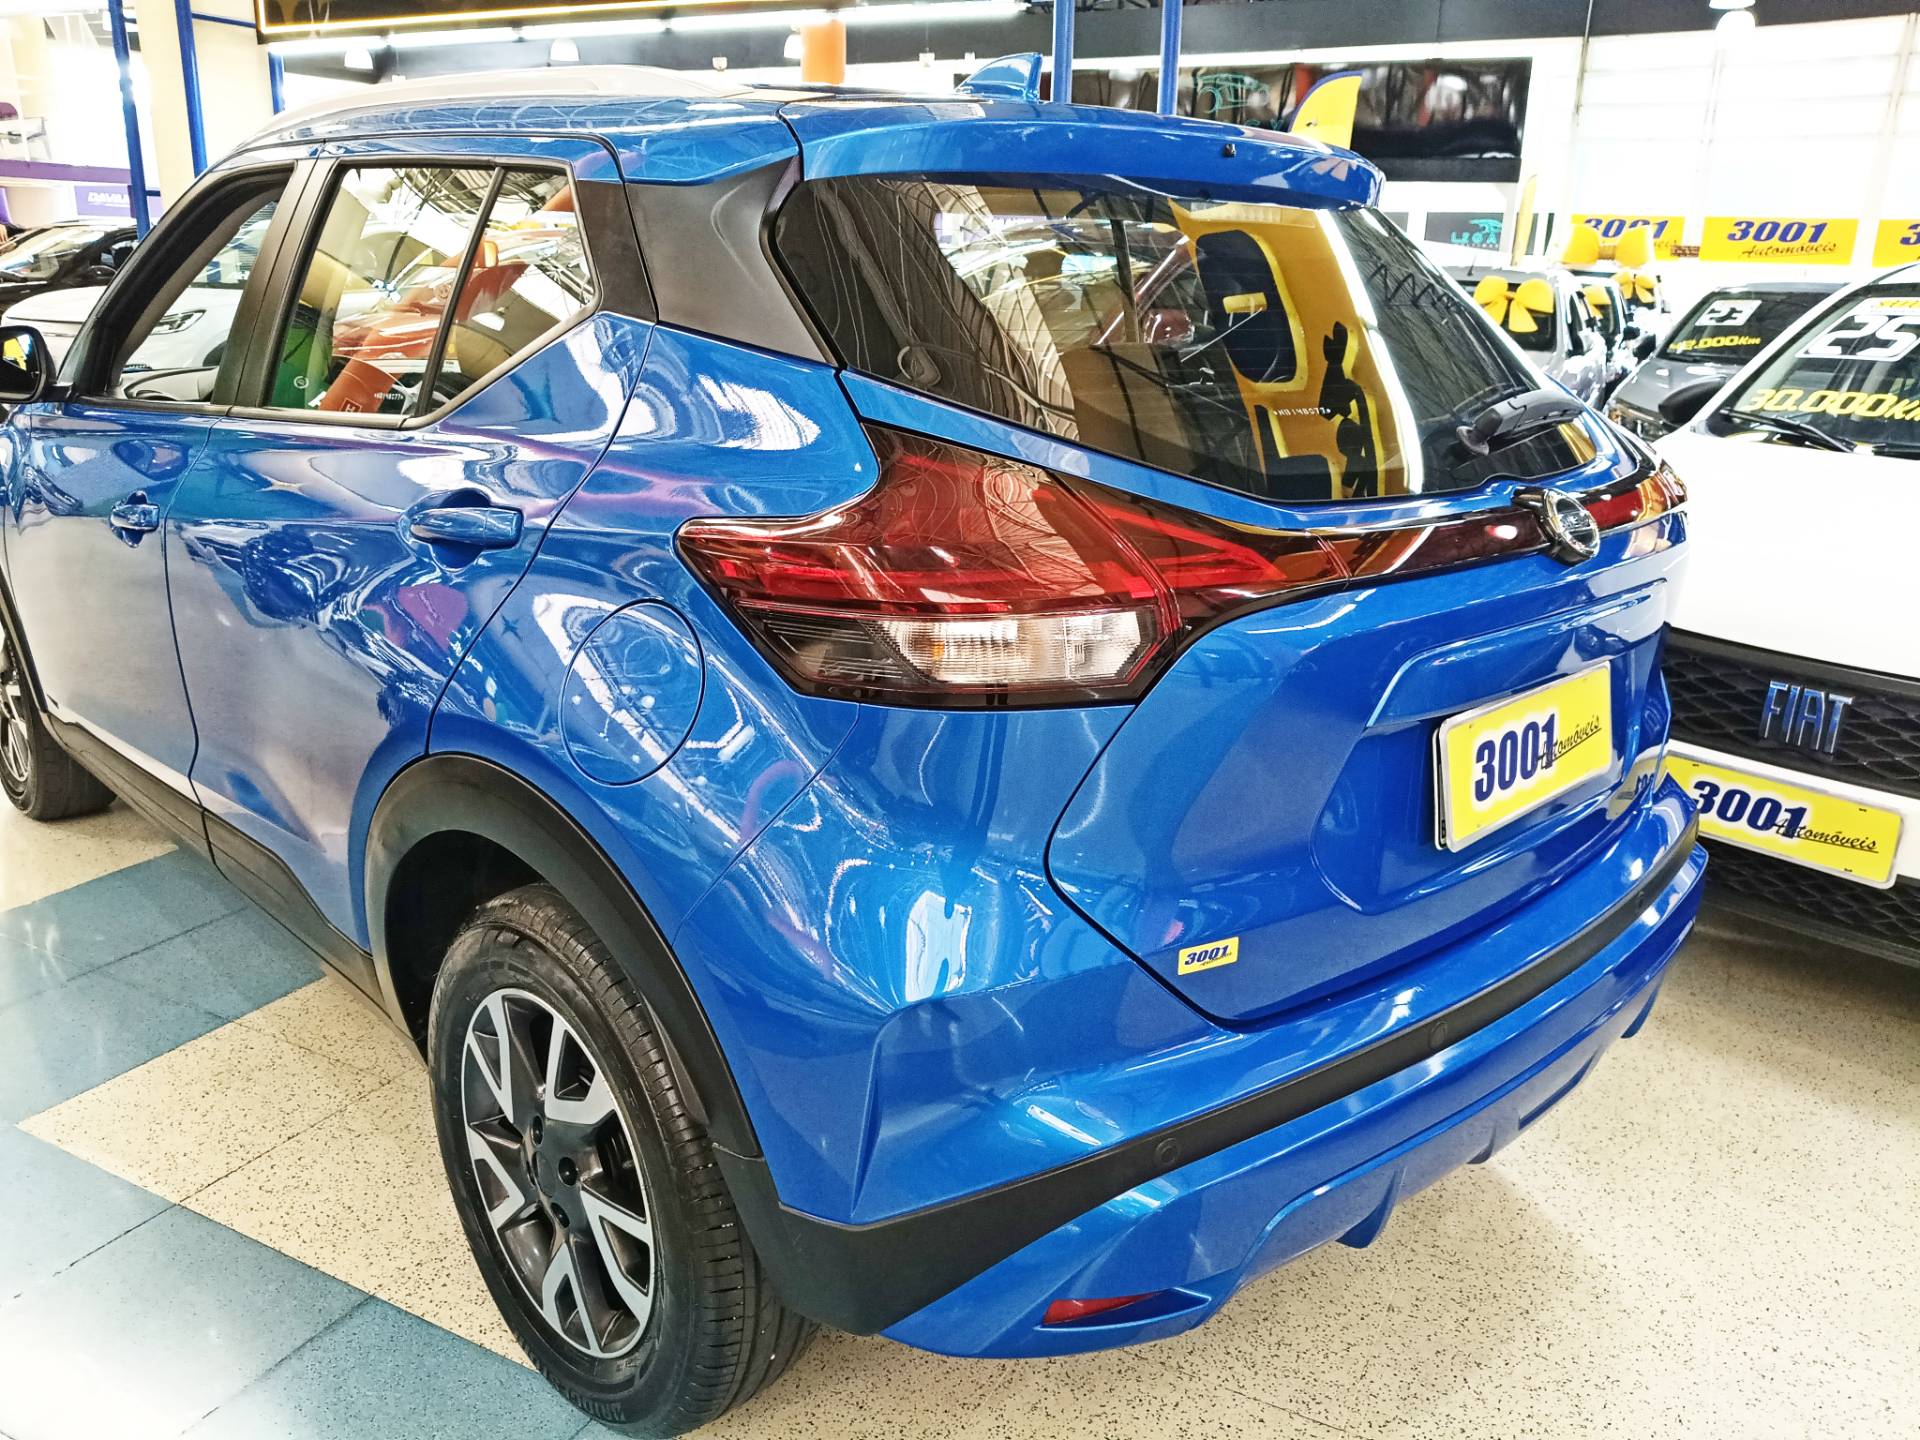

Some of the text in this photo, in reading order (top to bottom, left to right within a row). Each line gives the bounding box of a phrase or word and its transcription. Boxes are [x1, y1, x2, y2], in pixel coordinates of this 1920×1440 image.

[1727, 220, 1828, 243] 3001
[1760, 680, 1853, 754] FIAT
[1474, 713, 1556, 802] 3001
[1693, 780, 1808, 839] 3001
[1184, 944, 1230, 966] 3001
